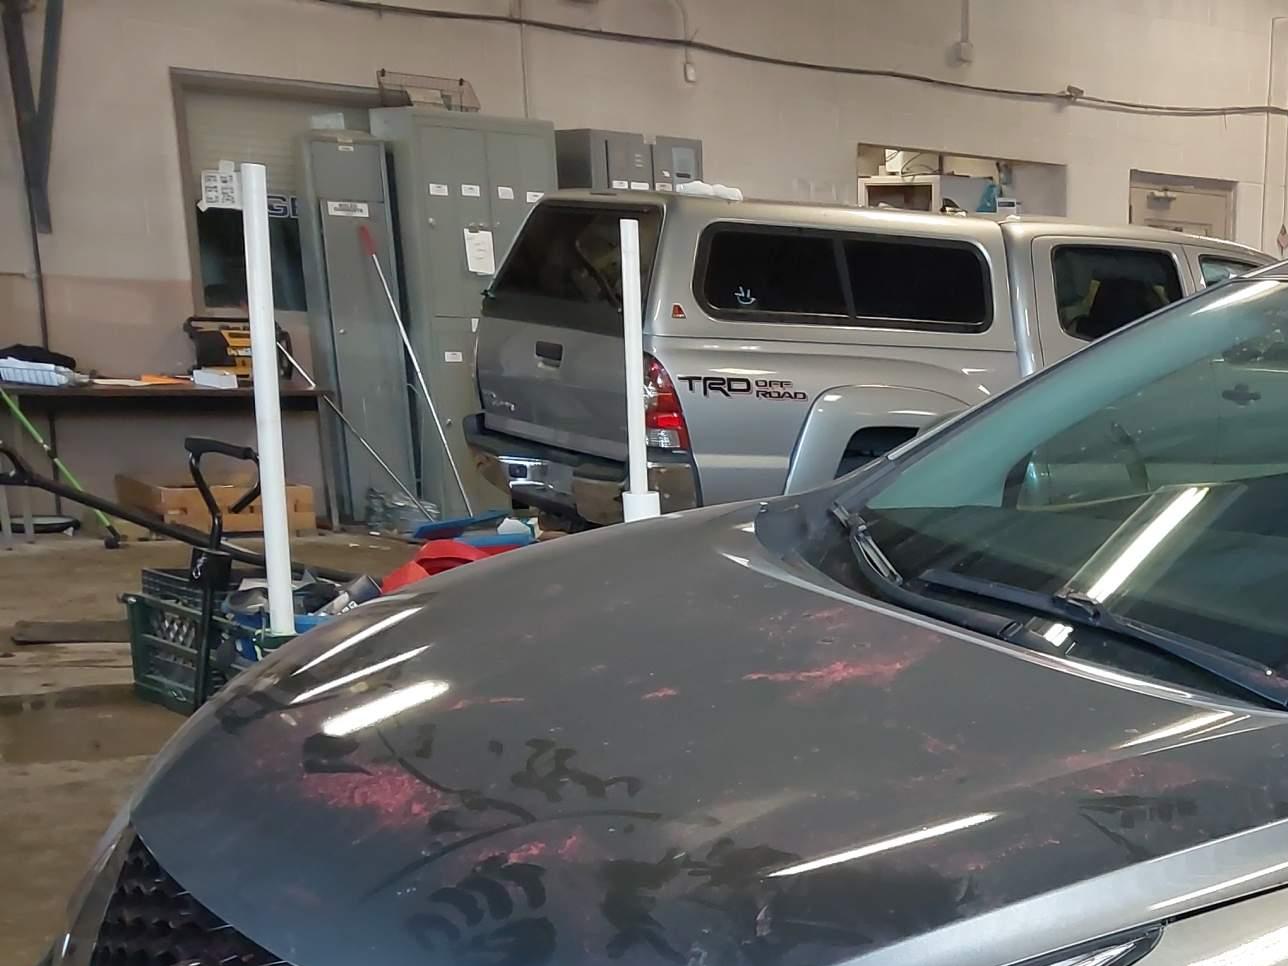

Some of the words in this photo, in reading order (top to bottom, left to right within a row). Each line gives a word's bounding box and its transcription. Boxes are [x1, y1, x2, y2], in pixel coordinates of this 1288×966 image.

[678, 376, 752, 397] TRD
[755, 379, 793, 388] OFF
[756, 390, 807, 399] ROAD
